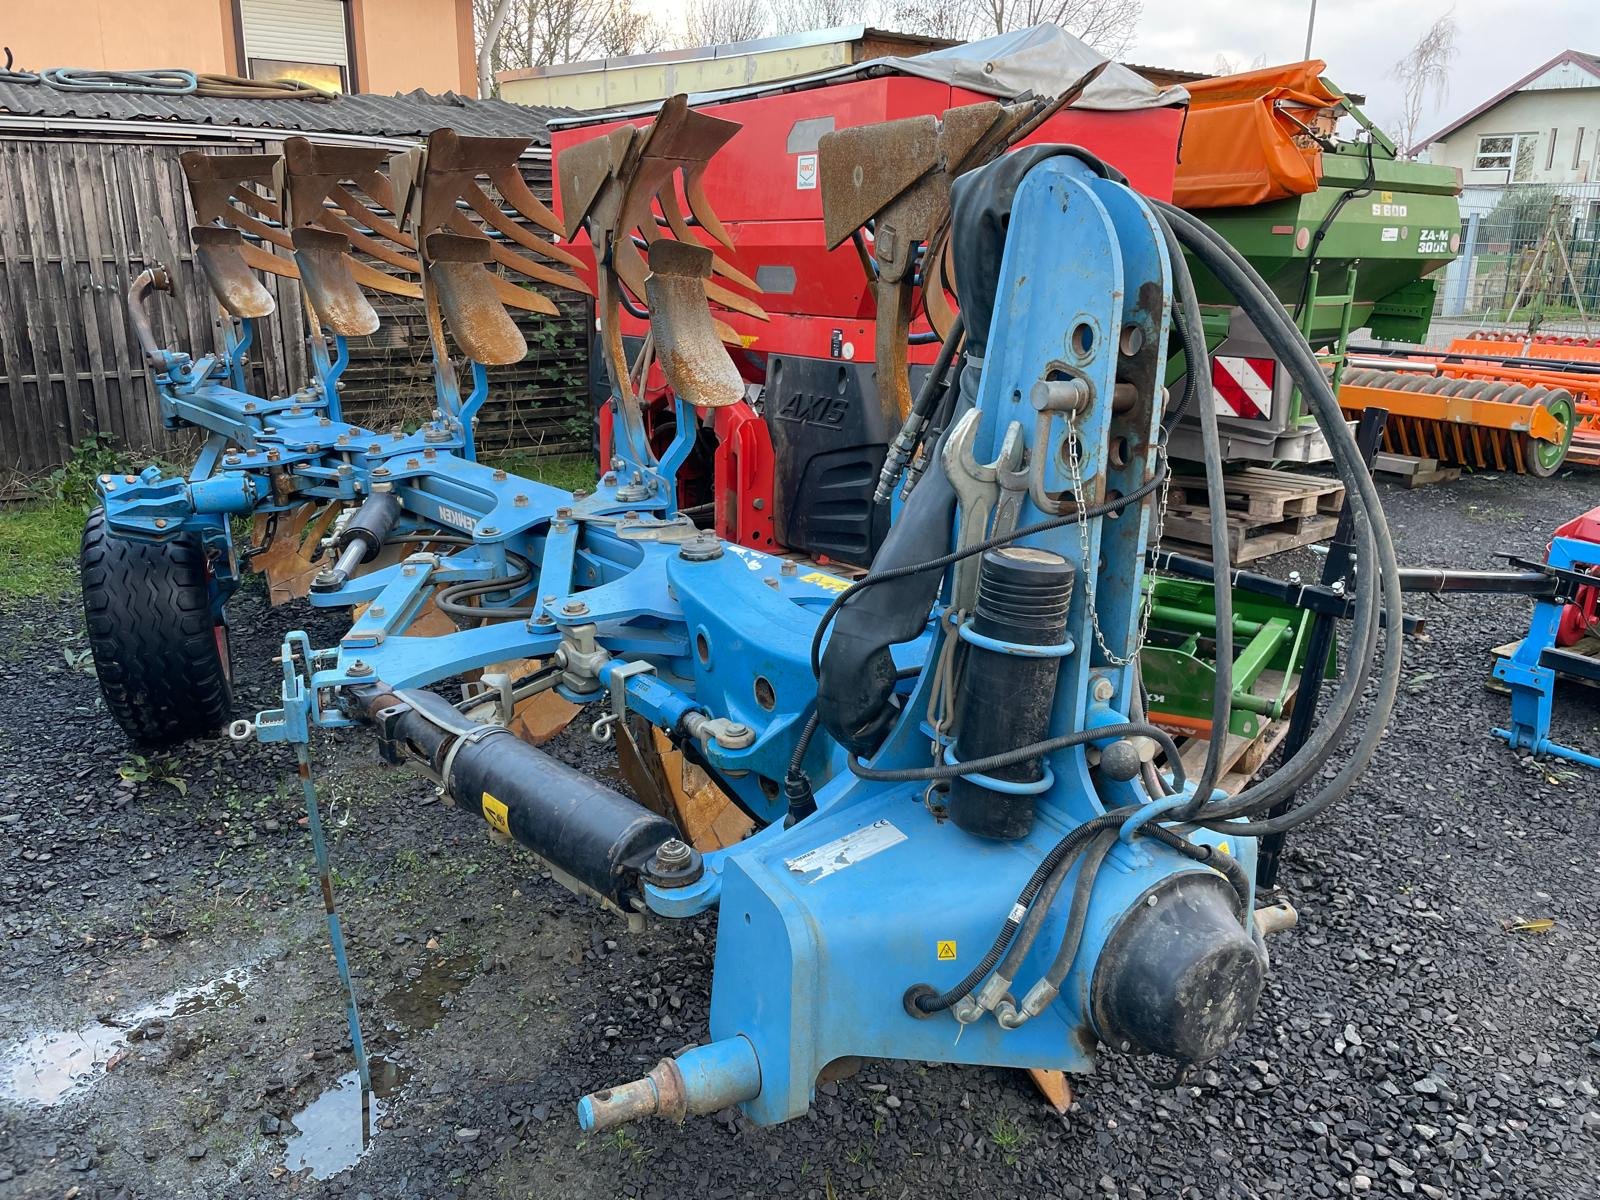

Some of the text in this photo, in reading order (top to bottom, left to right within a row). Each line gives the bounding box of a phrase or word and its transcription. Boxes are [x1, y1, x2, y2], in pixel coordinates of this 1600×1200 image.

[1372, 203, 1381, 216] S
[1419, 229, 1449, 241] ZA-M
[780, 391, 849, 424] AXIS
[438, 505, 478, 532] LEMKEN
